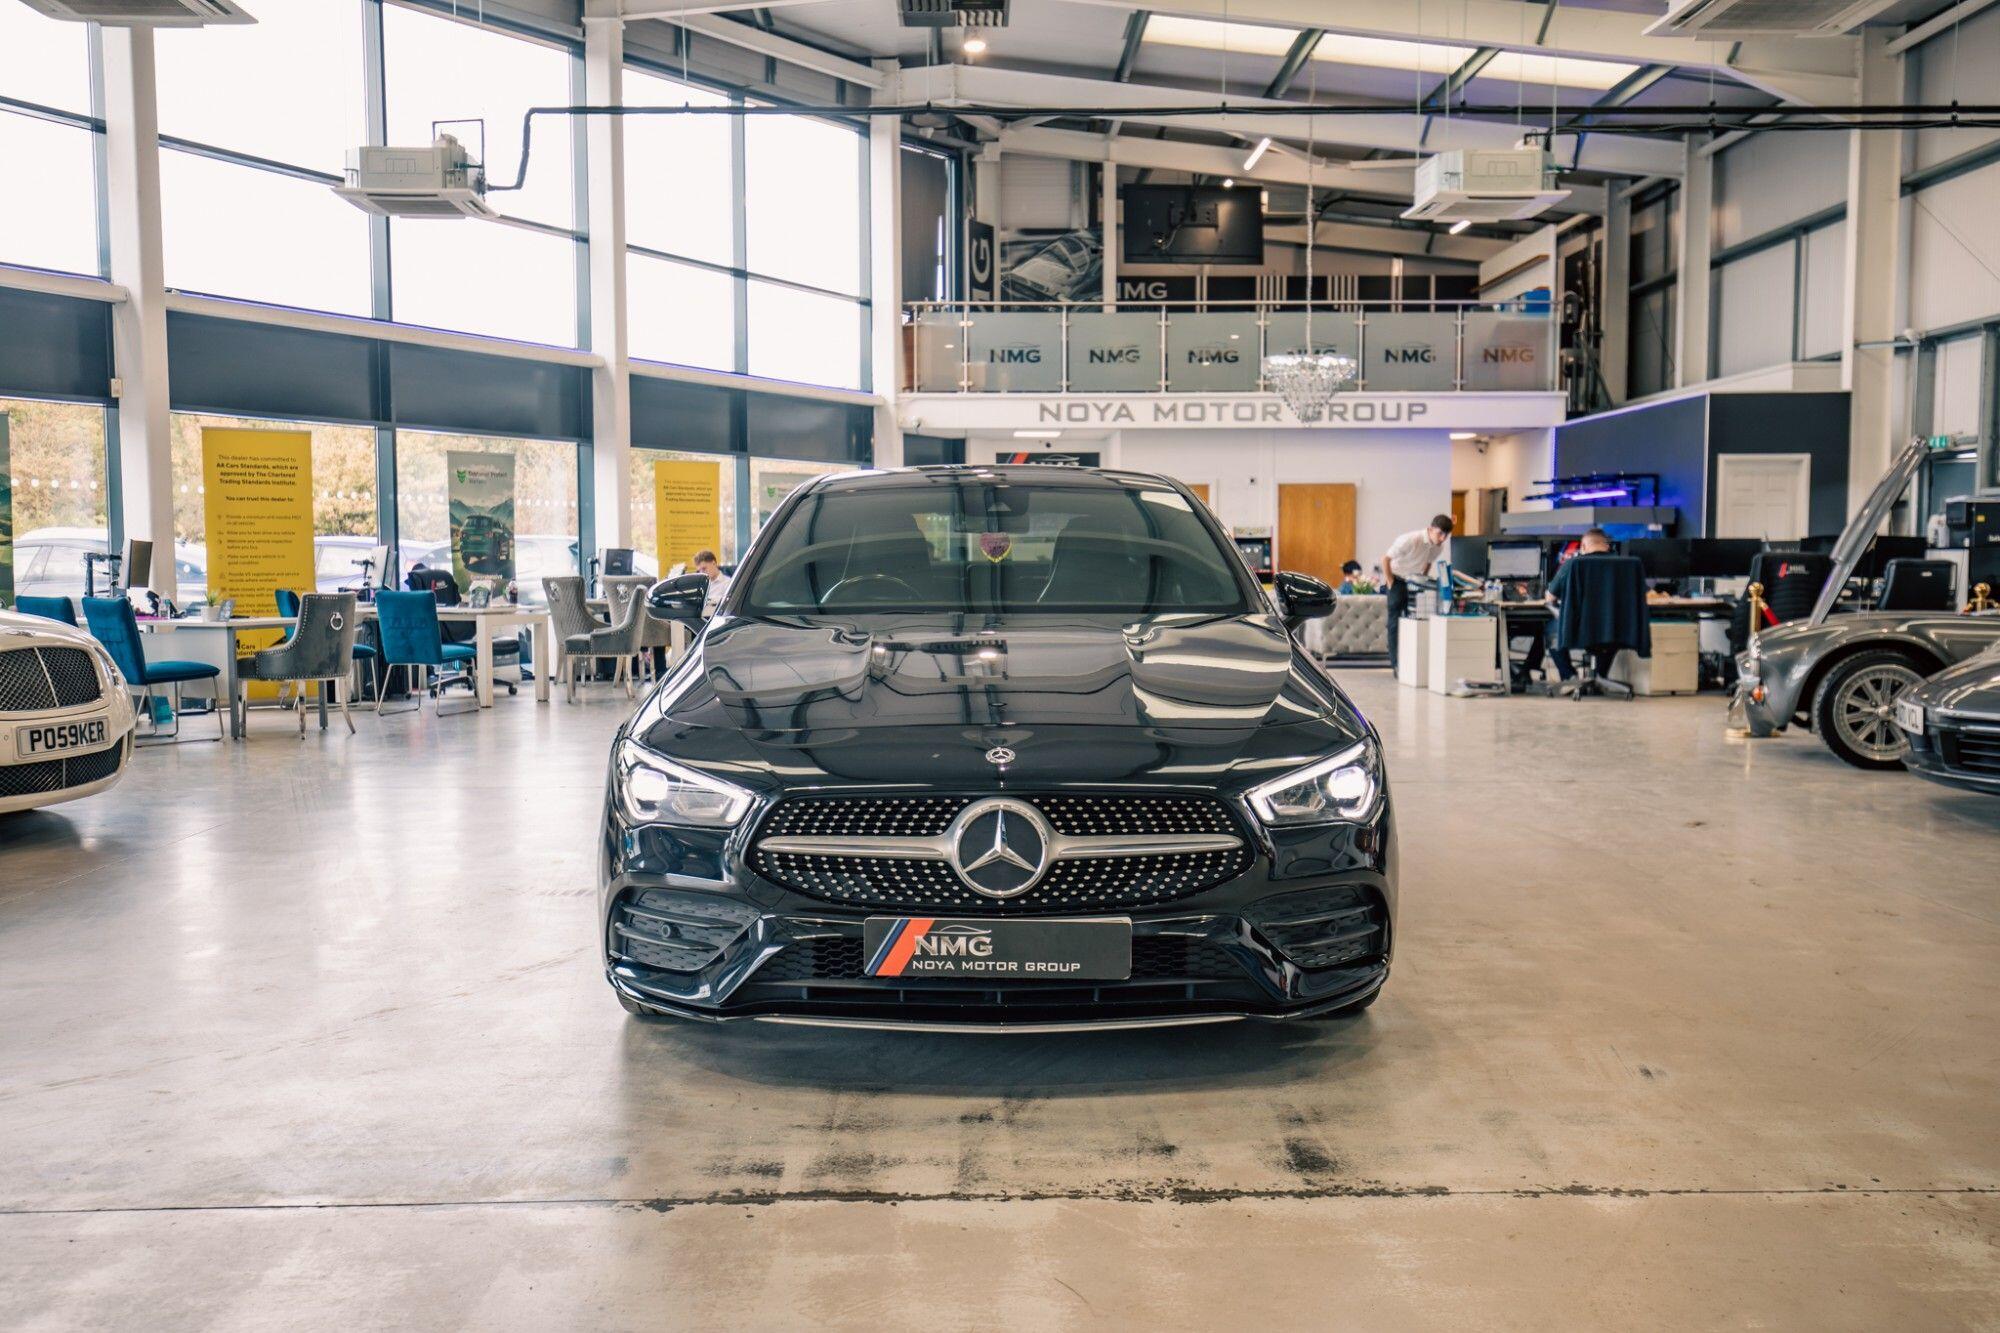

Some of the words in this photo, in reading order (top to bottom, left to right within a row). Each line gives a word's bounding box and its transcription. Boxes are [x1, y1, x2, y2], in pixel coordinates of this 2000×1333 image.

[1117, 282, 1168, 299] MG
[990, 349, 1041, 364] NMG
[1483, 350, 1534, 363] NMG
[1039, 402, 1136, 422] NOYA
[1154, 402, 1282, 422] MOTOR
[30, 720, 105, 752] PO59KER
[914, 935, 993, 957] NMG
[912, 960, 955, 971] NOYA
[962, 961, 1018, 972] MOTOR
[1025, 962, 1081, 972] GROUP
